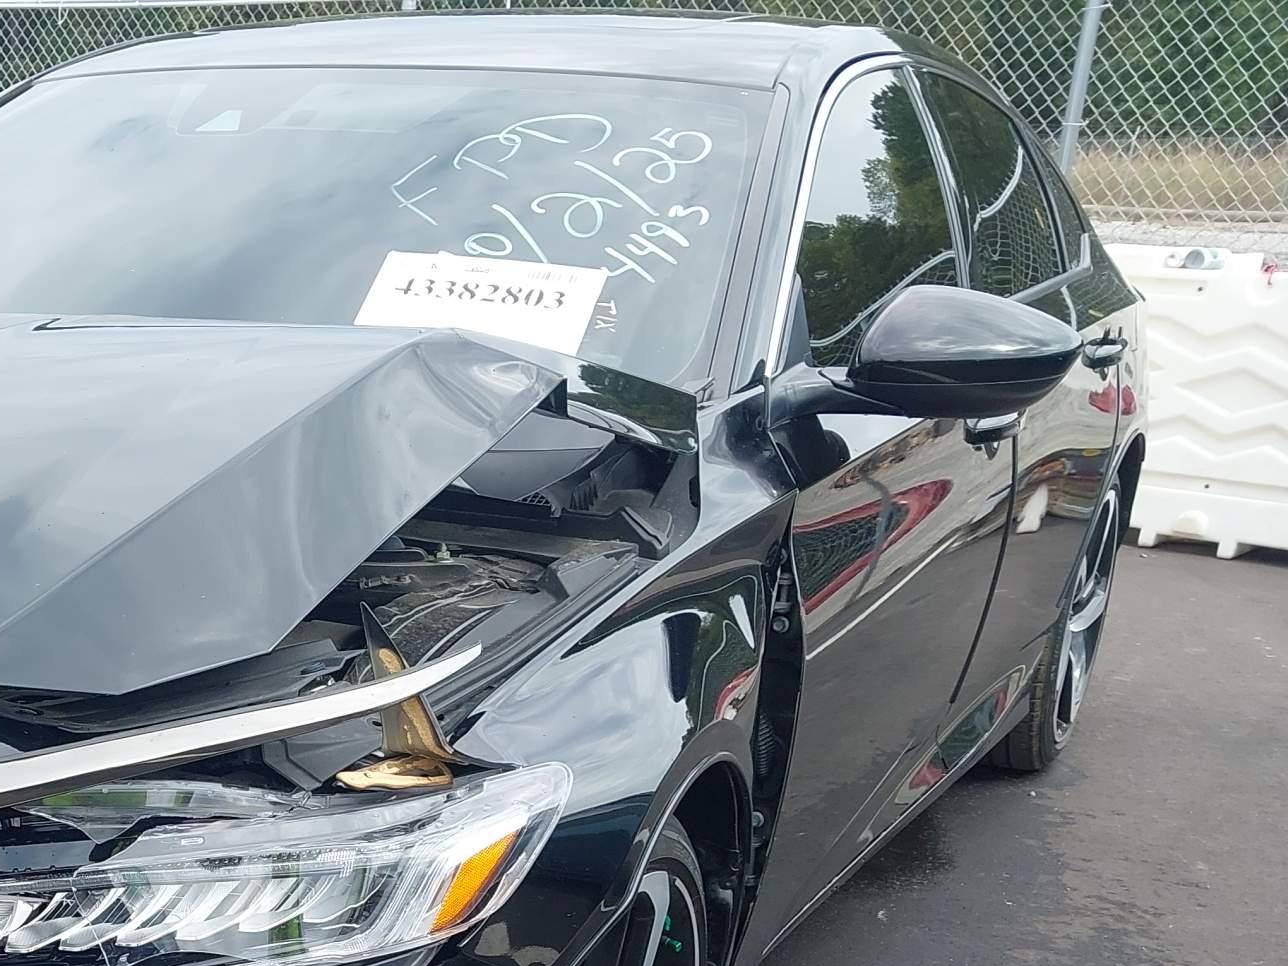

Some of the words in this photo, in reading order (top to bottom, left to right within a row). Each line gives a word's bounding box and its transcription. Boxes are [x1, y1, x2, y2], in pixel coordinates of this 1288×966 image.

[454, 126, 713, 264] 0/2/25
[600, 204, 710, 284] 4493
[394, 277, 567, 310] 43382803
